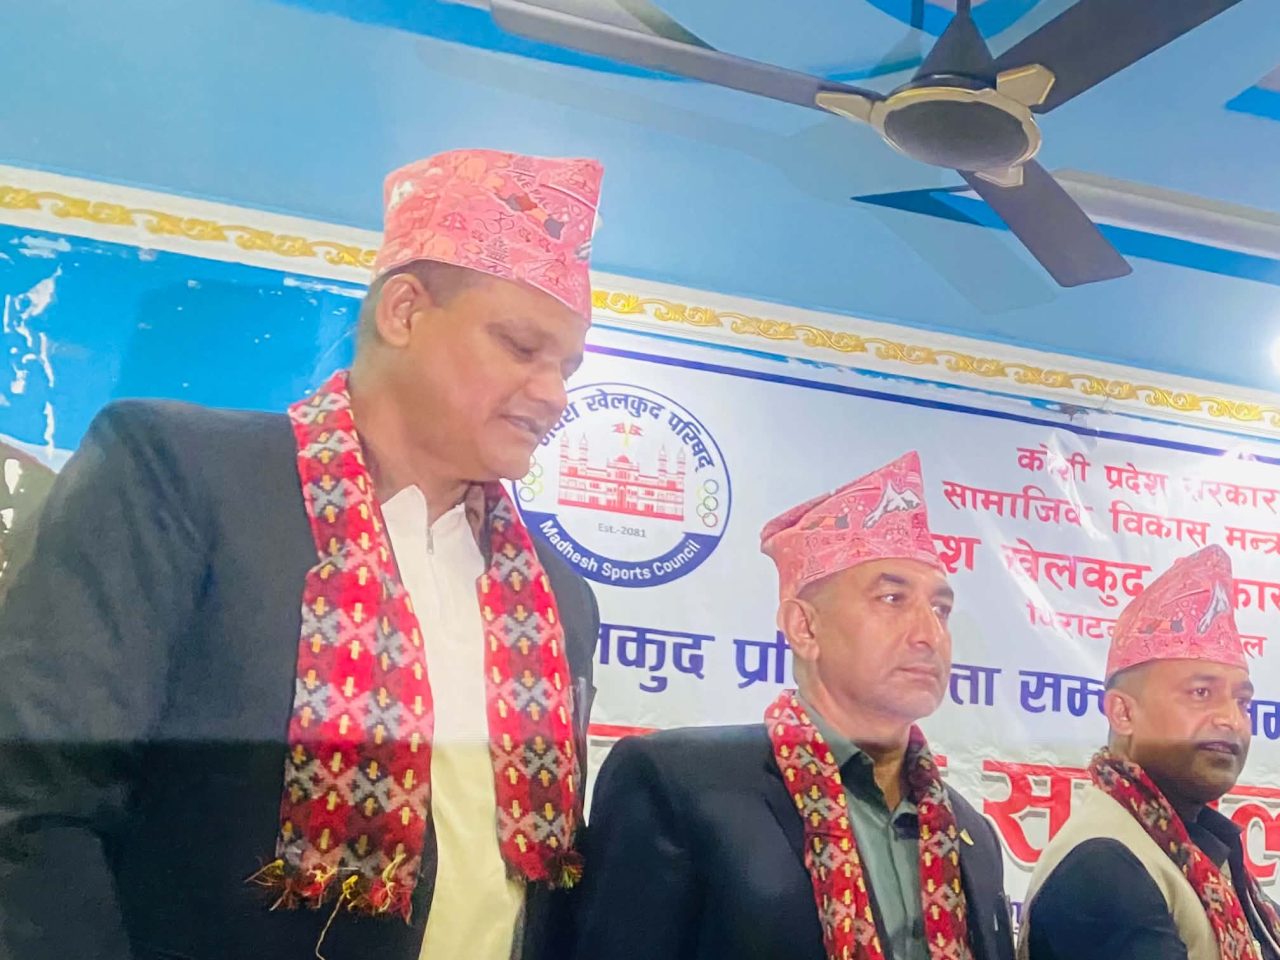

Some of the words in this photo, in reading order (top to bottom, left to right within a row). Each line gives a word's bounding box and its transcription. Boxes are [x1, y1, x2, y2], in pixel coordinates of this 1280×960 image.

[540, 520, 598, 572] Madhesh
[601, 564, 651, 580] Sports
[652, 539, 701, 576] Council
[1109, 500, 1210, 548] विकास
